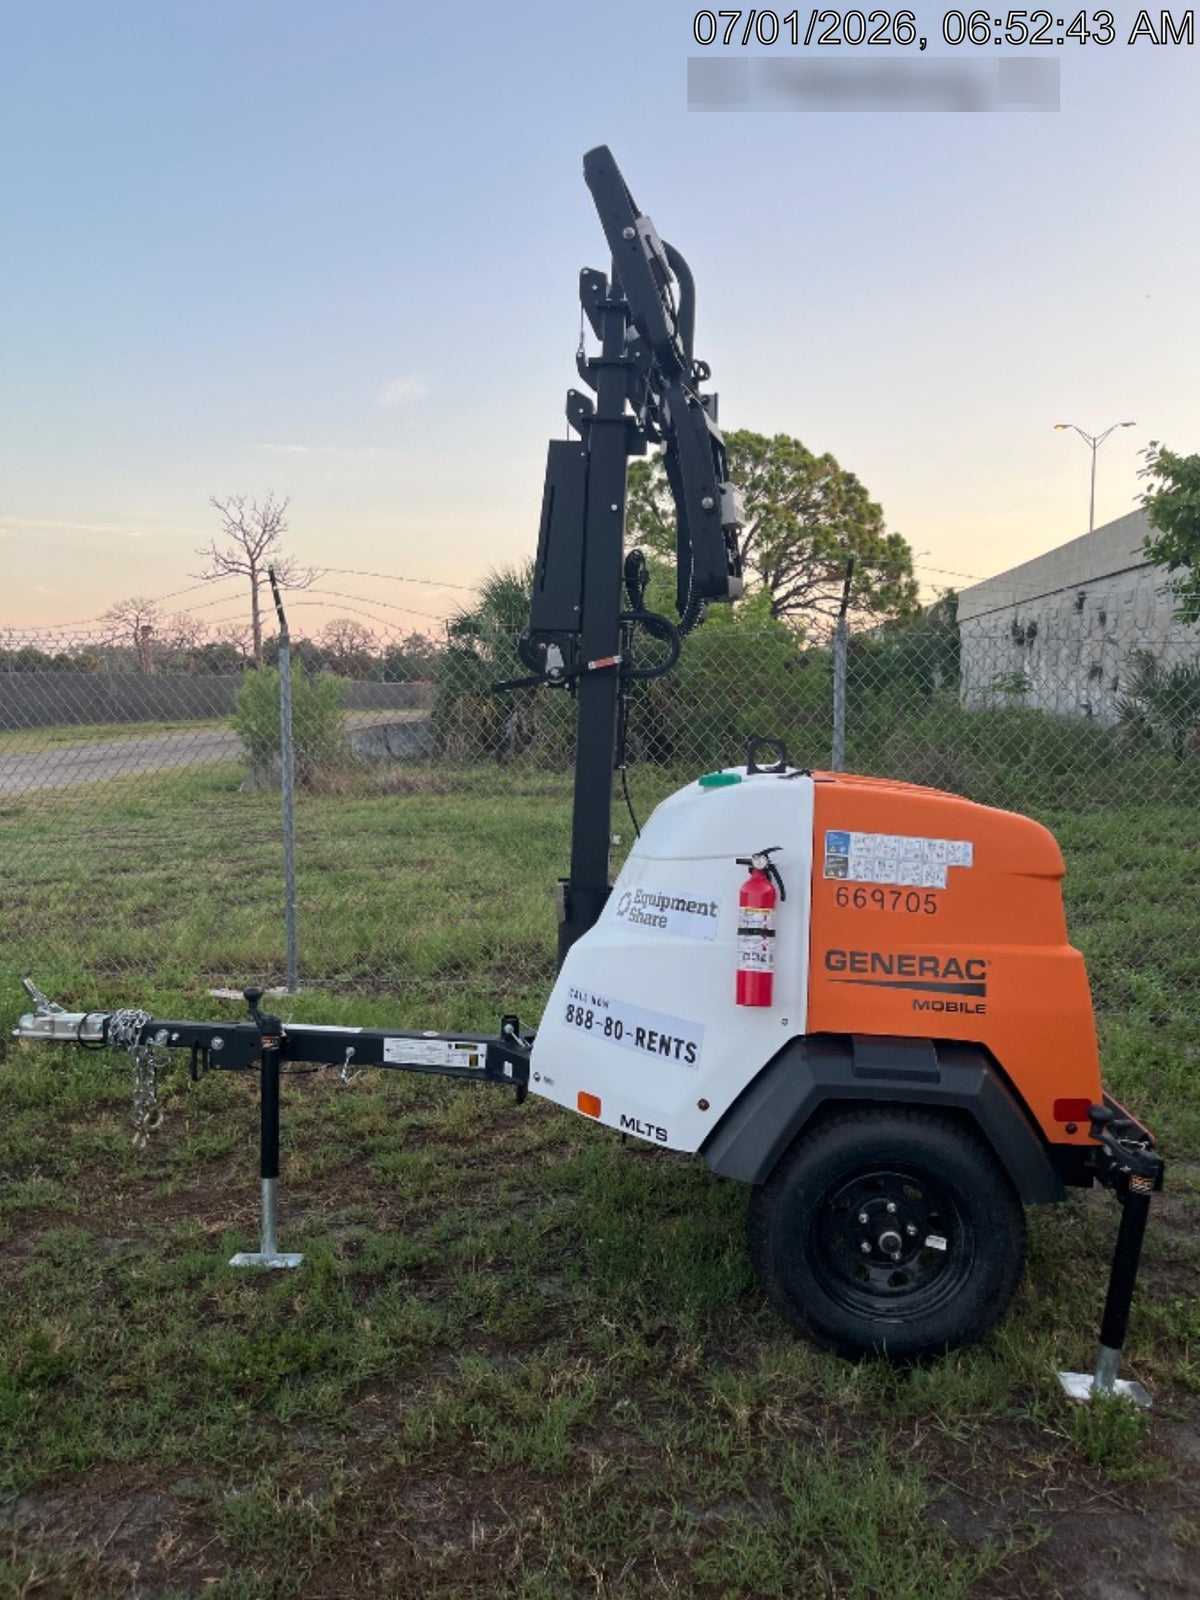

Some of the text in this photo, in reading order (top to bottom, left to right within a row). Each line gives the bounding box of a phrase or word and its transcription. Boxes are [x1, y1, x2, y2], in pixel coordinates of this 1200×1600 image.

[633, 888, 719, 918] Equipment
[836, 886, 937, 915] 669705
[628, 907, 668, 929] Share
[824, 949, 987, 981] GENERAC
[912, 999, 988, 1015] MOBILE
[565, 1004, 699, 1065] 888-80-RENTS
[620, 1114, 669, 1143] MLTS
